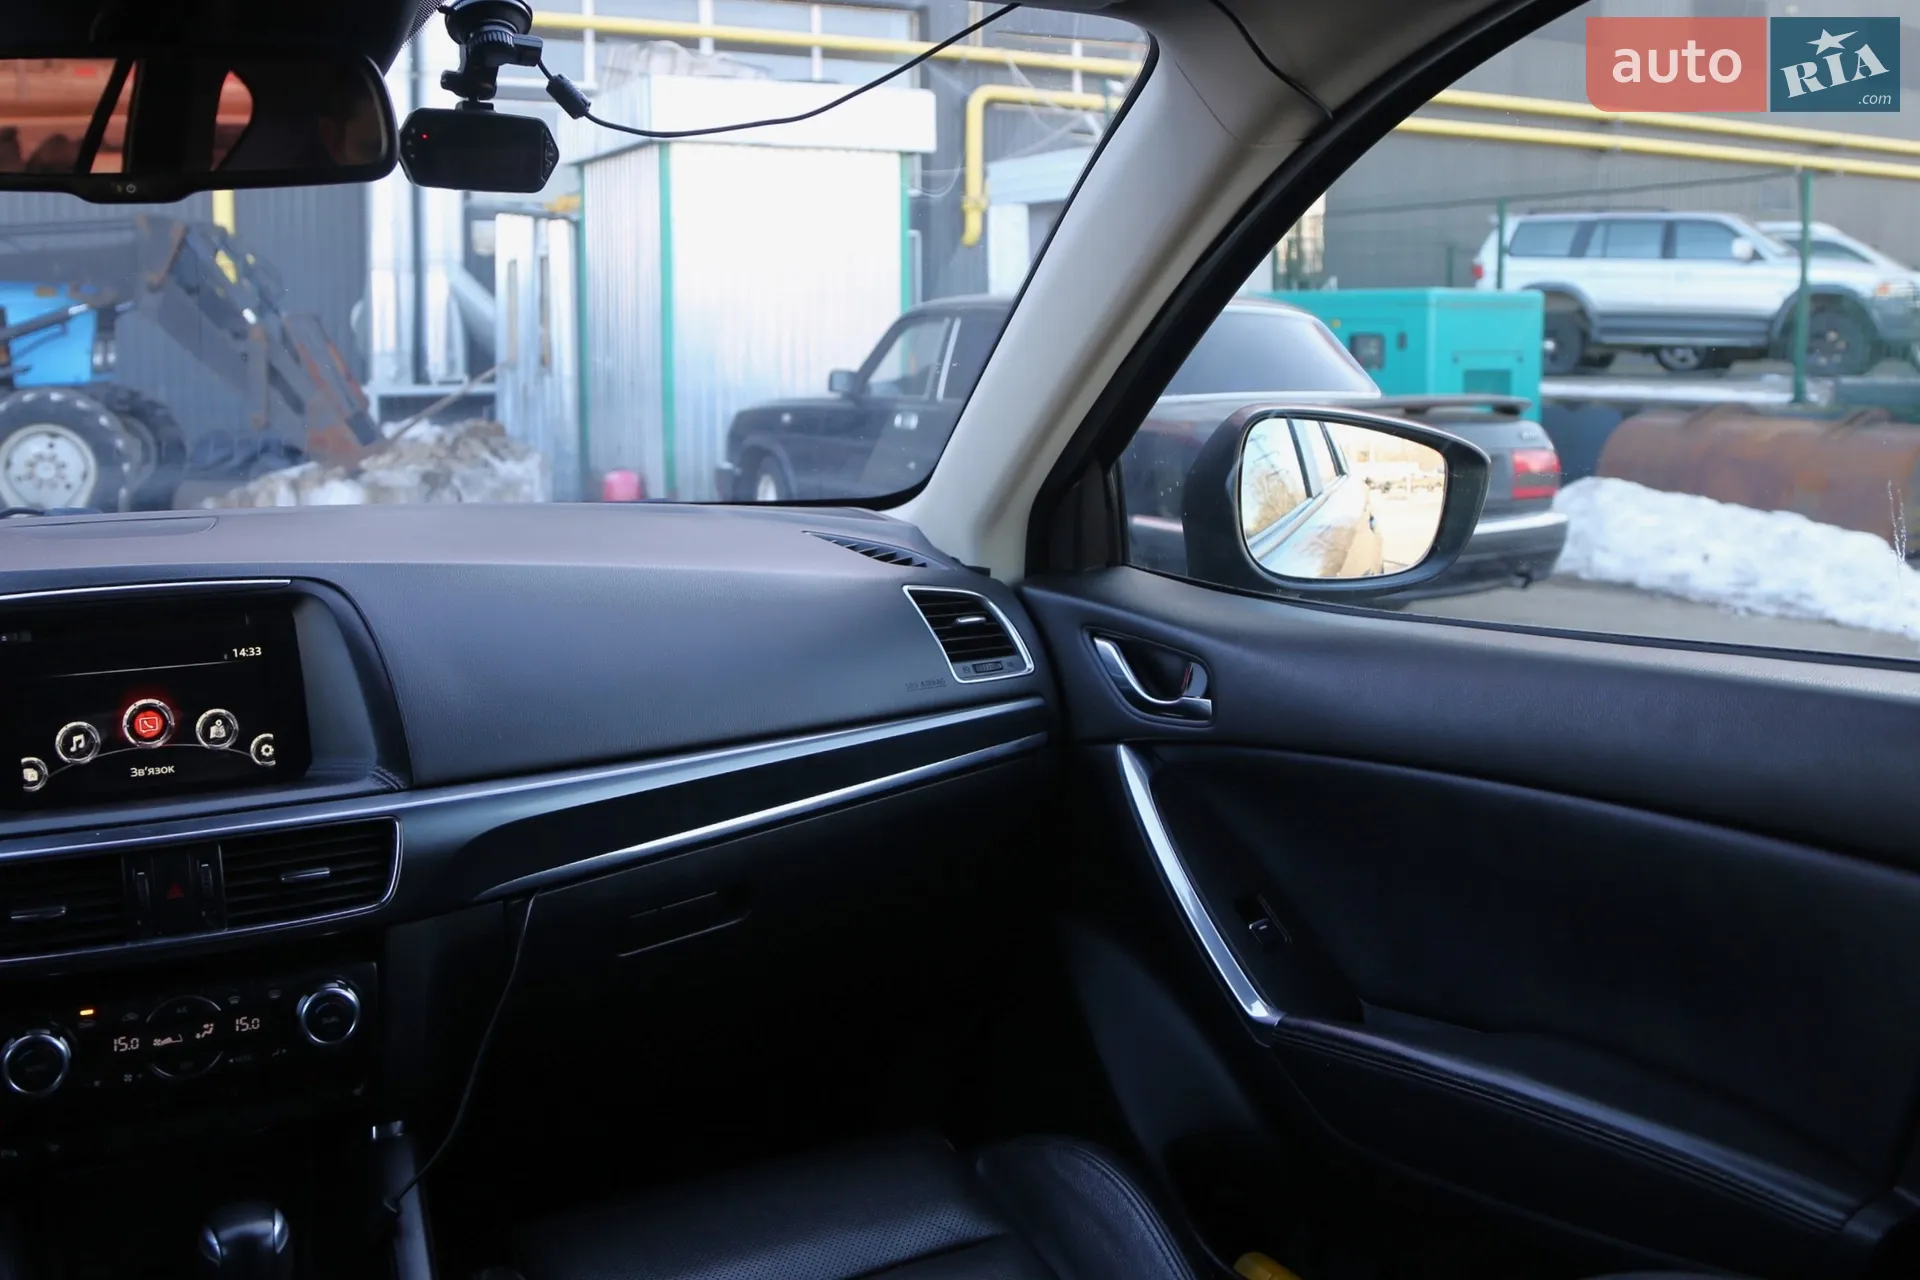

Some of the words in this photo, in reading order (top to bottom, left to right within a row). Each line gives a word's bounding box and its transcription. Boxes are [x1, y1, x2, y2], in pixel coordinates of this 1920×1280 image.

[232, 646, 262, 658] 14:33
[235, 1016, 260, 1032] 15.0
[113, 1036, 140, 1052] 15.0
